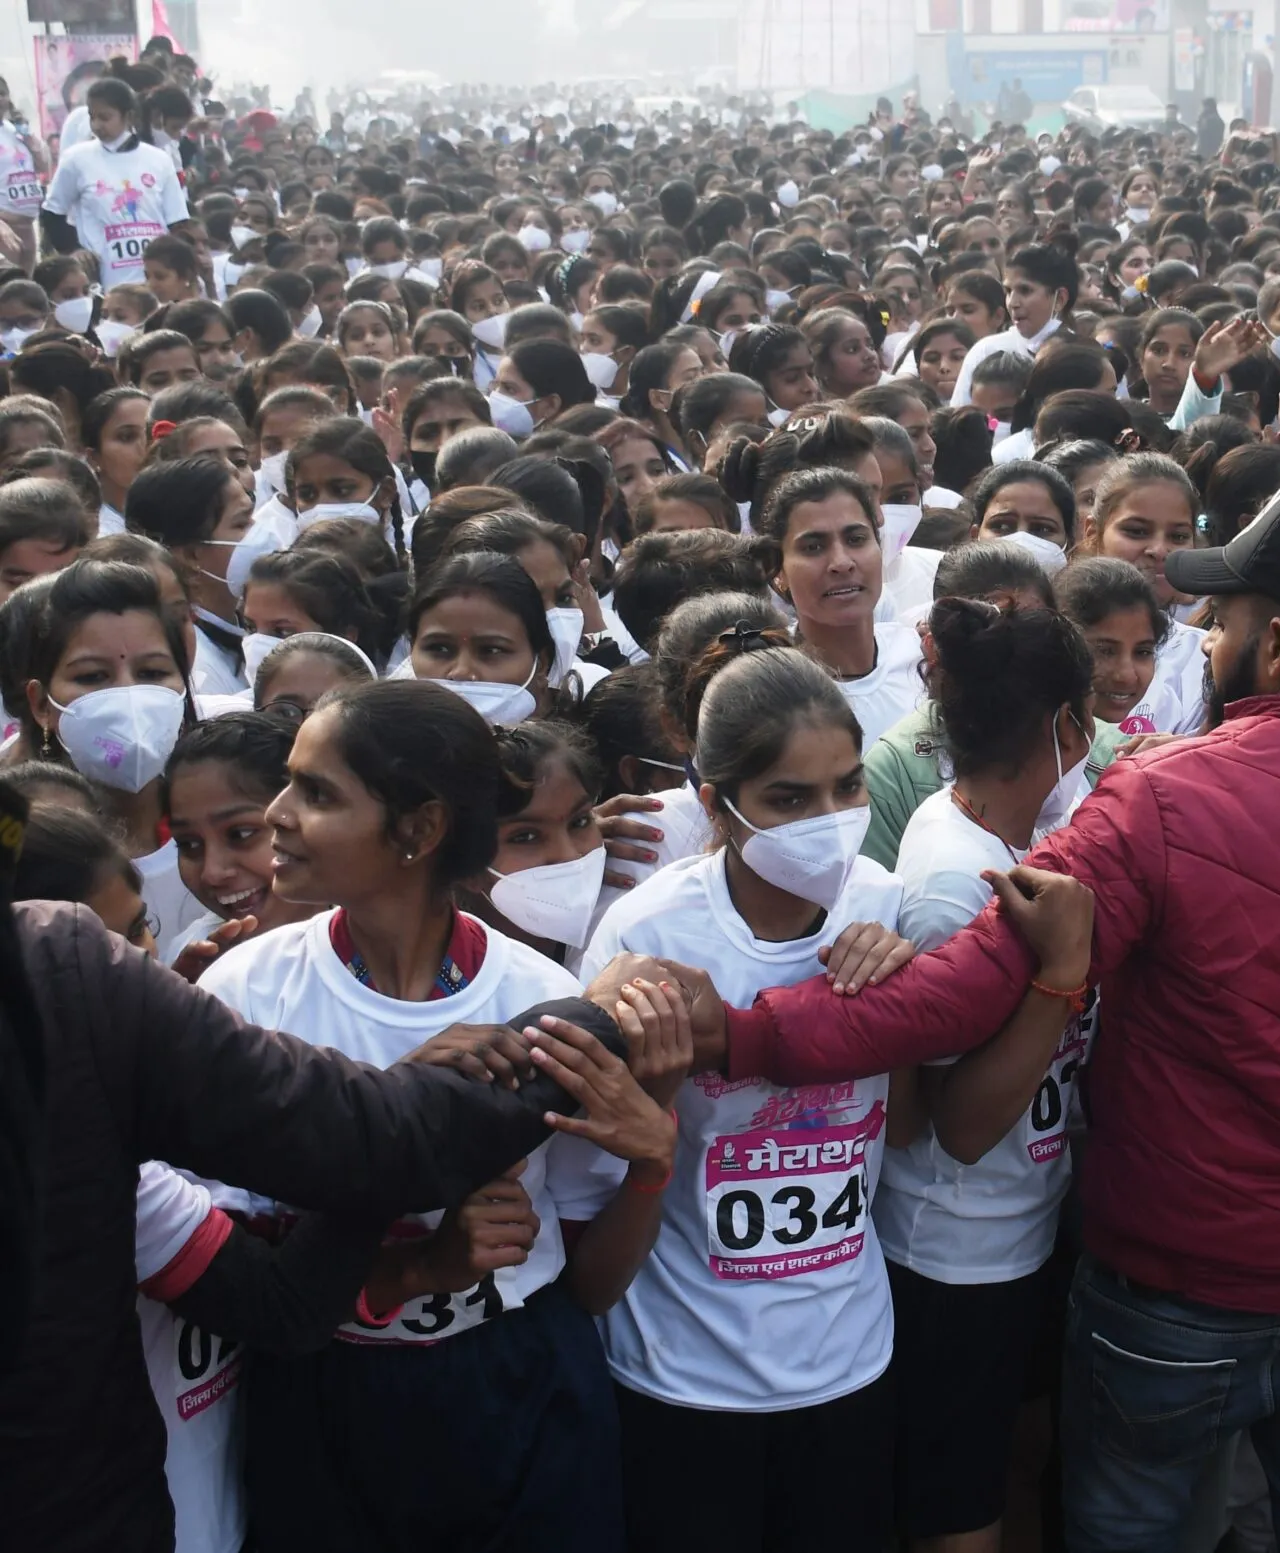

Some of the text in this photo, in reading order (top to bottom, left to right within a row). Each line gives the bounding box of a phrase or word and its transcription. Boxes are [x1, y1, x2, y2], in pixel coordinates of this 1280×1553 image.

[1032, 1140, 1061, 1159] जिला
[718, 1260, 759, 1274] जिला
[761, 1257, 786, 1275] एवं
[788, 1253, 822, 1269] शहर
